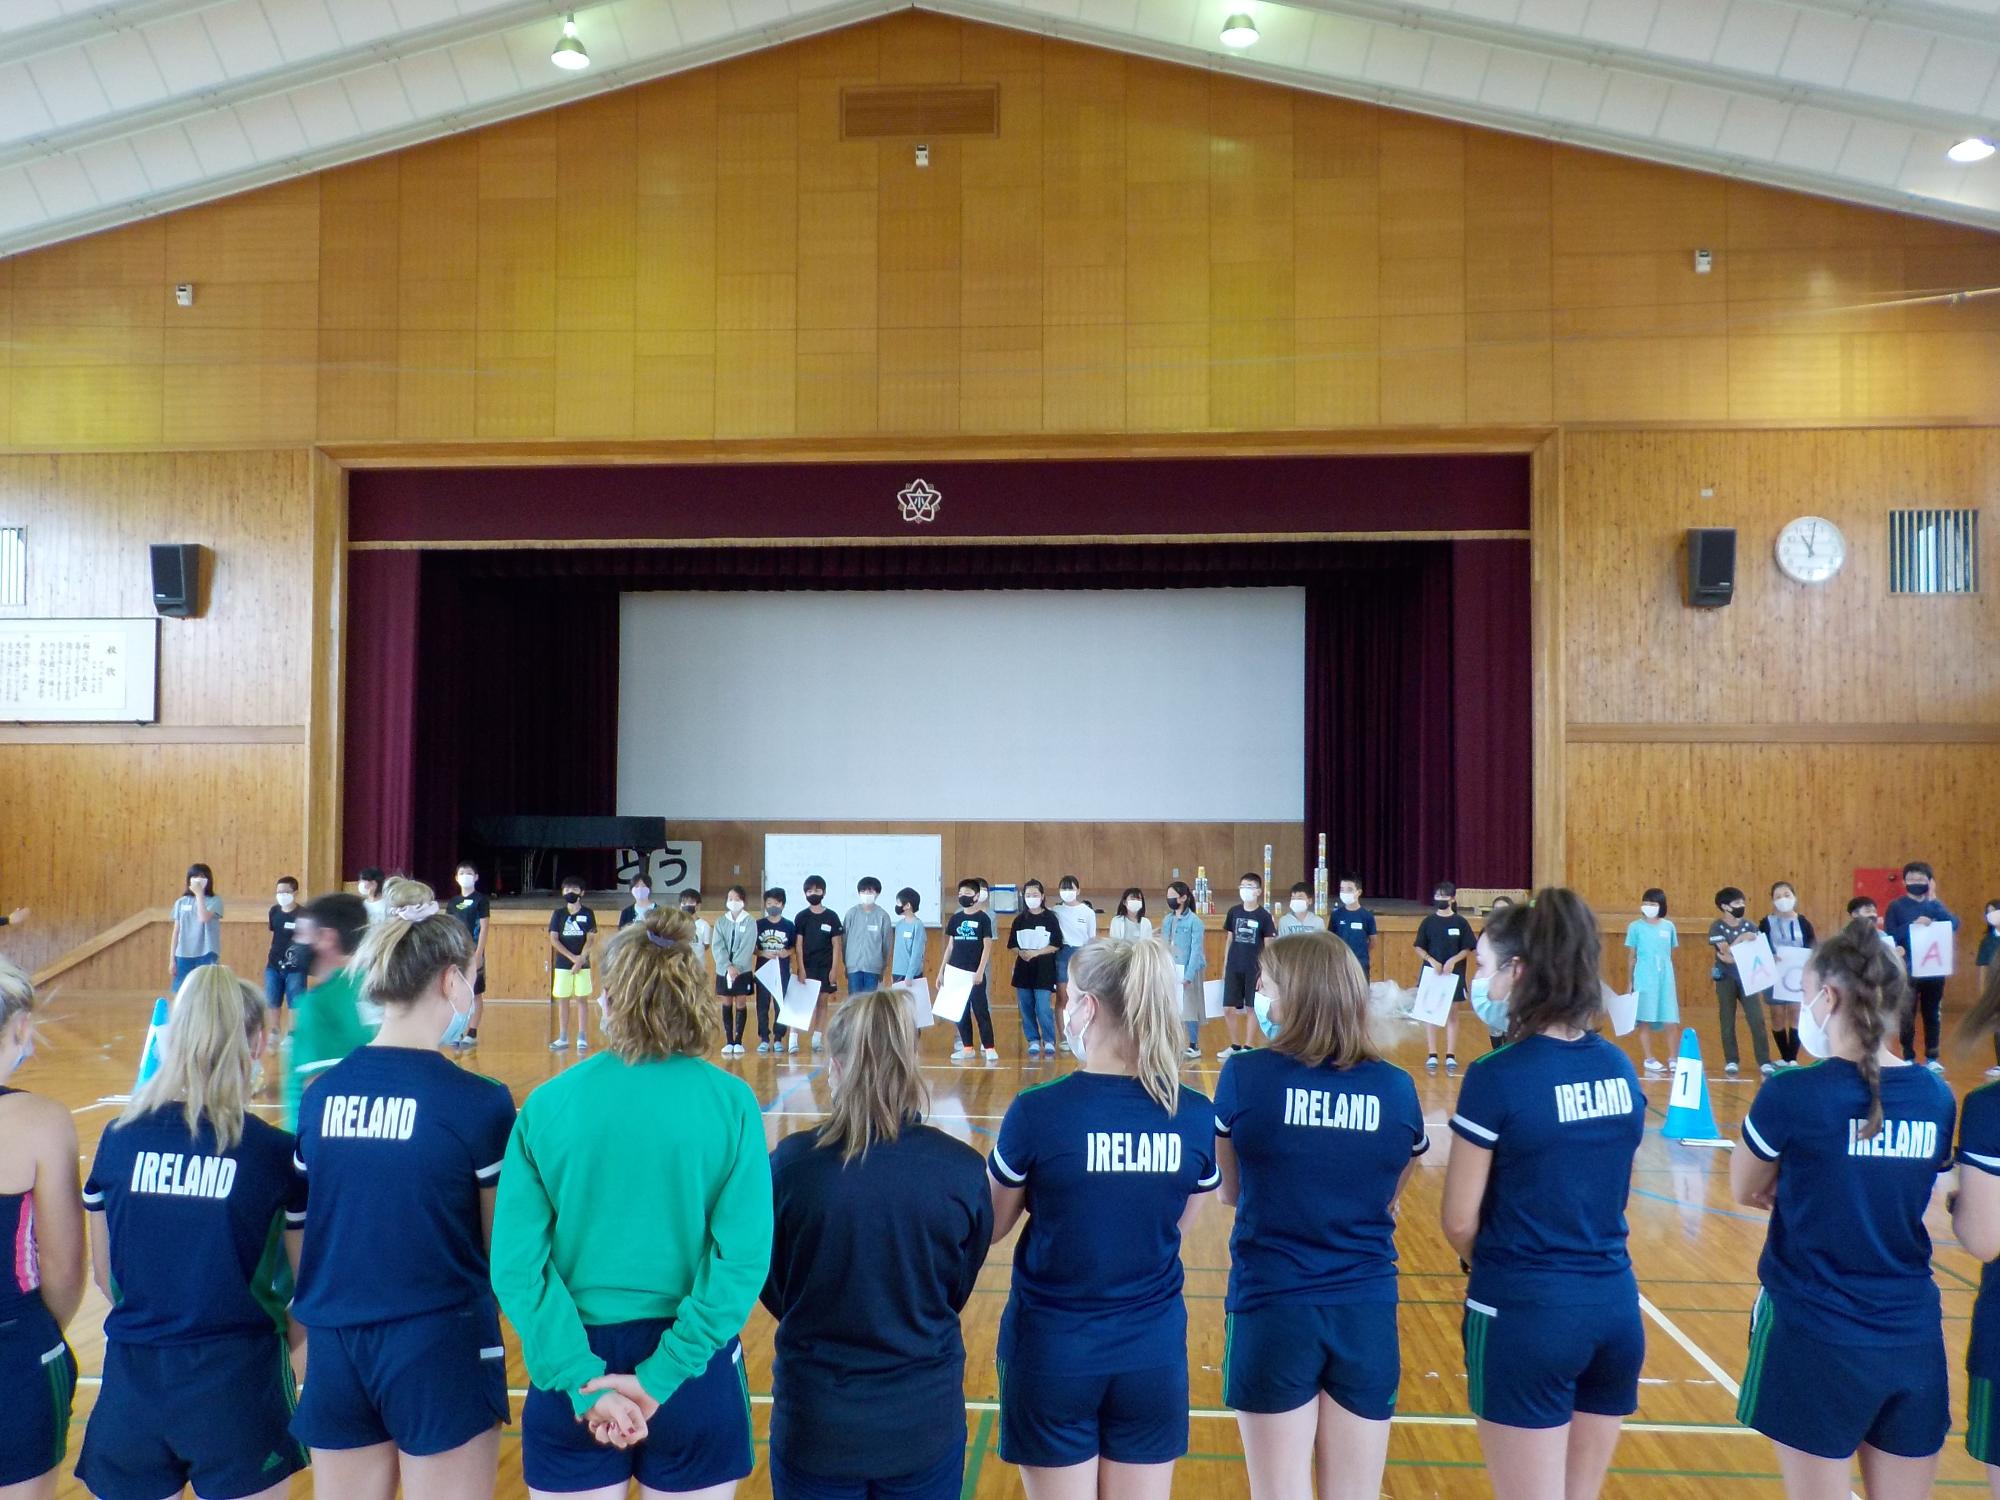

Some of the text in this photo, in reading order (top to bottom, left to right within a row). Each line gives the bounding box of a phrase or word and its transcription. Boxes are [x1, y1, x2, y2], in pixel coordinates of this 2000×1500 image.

[1921, 941, 1942, 966] A
[1555, 1077, 1633, 1123] IRELAND
[1681, 1072, 1688, 1095] 1
[322, 1095, 417, 1140] IRELAND
[1284, 1088, 1380, 1131] IRELAND
[1087, 1132, 1182, 1172] IRELAND
[131, 1151, 238, 1199] IRELAND
